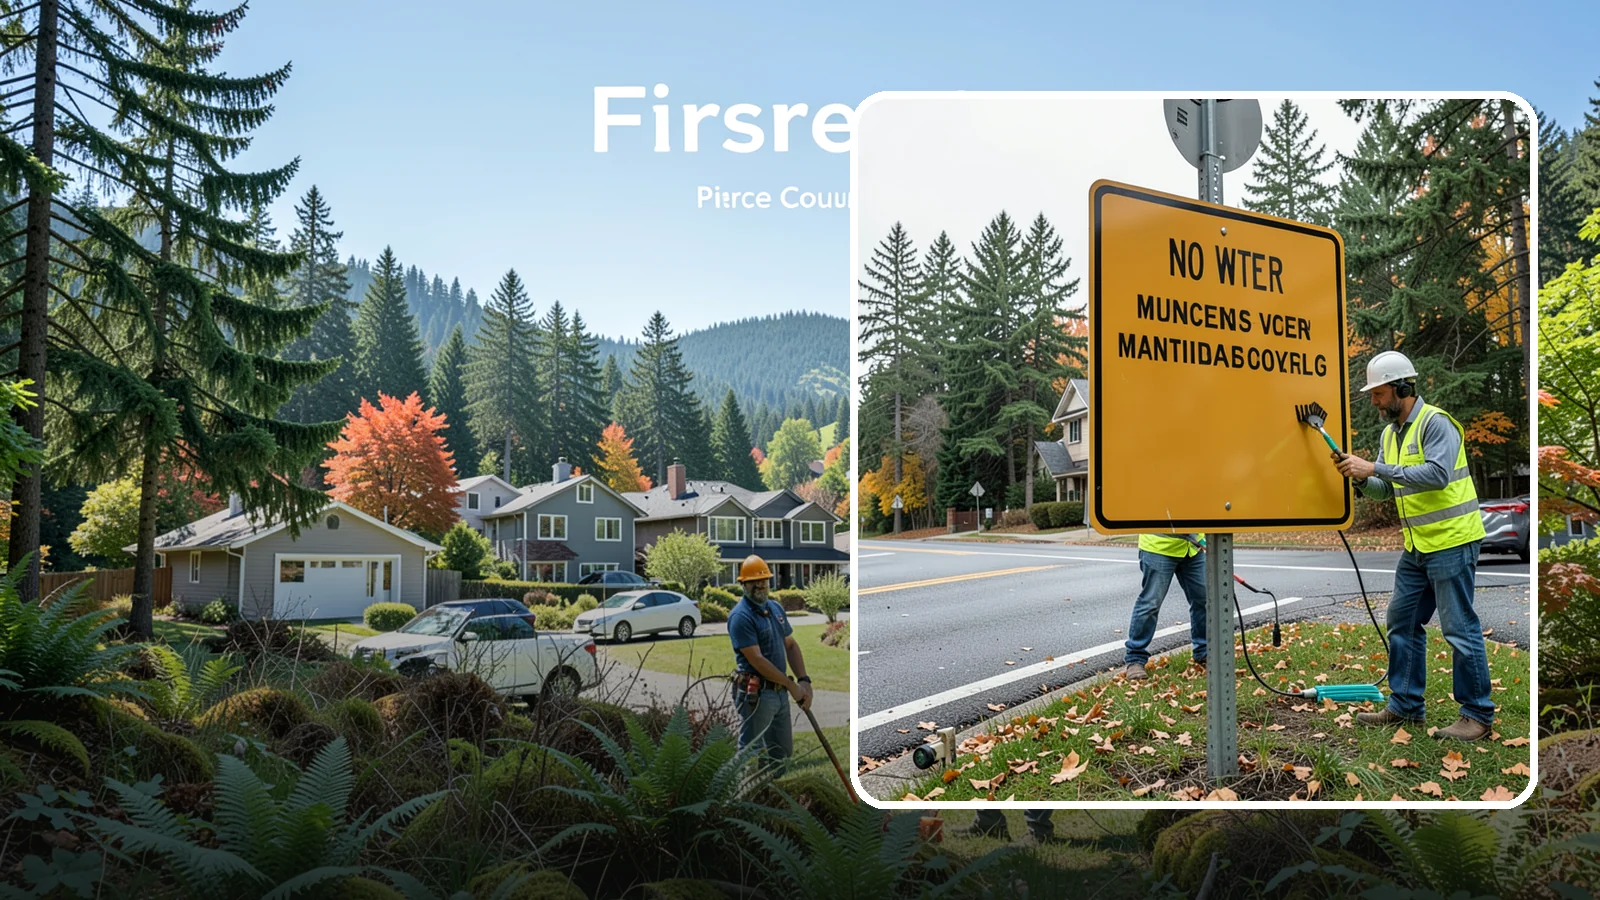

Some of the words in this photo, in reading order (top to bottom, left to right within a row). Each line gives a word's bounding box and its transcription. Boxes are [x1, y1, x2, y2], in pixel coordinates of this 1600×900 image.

[1169, 237, 1204, 281] NO
[1214, 244, 1284, 294] WTER
[1136, 293, 1252, 334] MUNCENS
